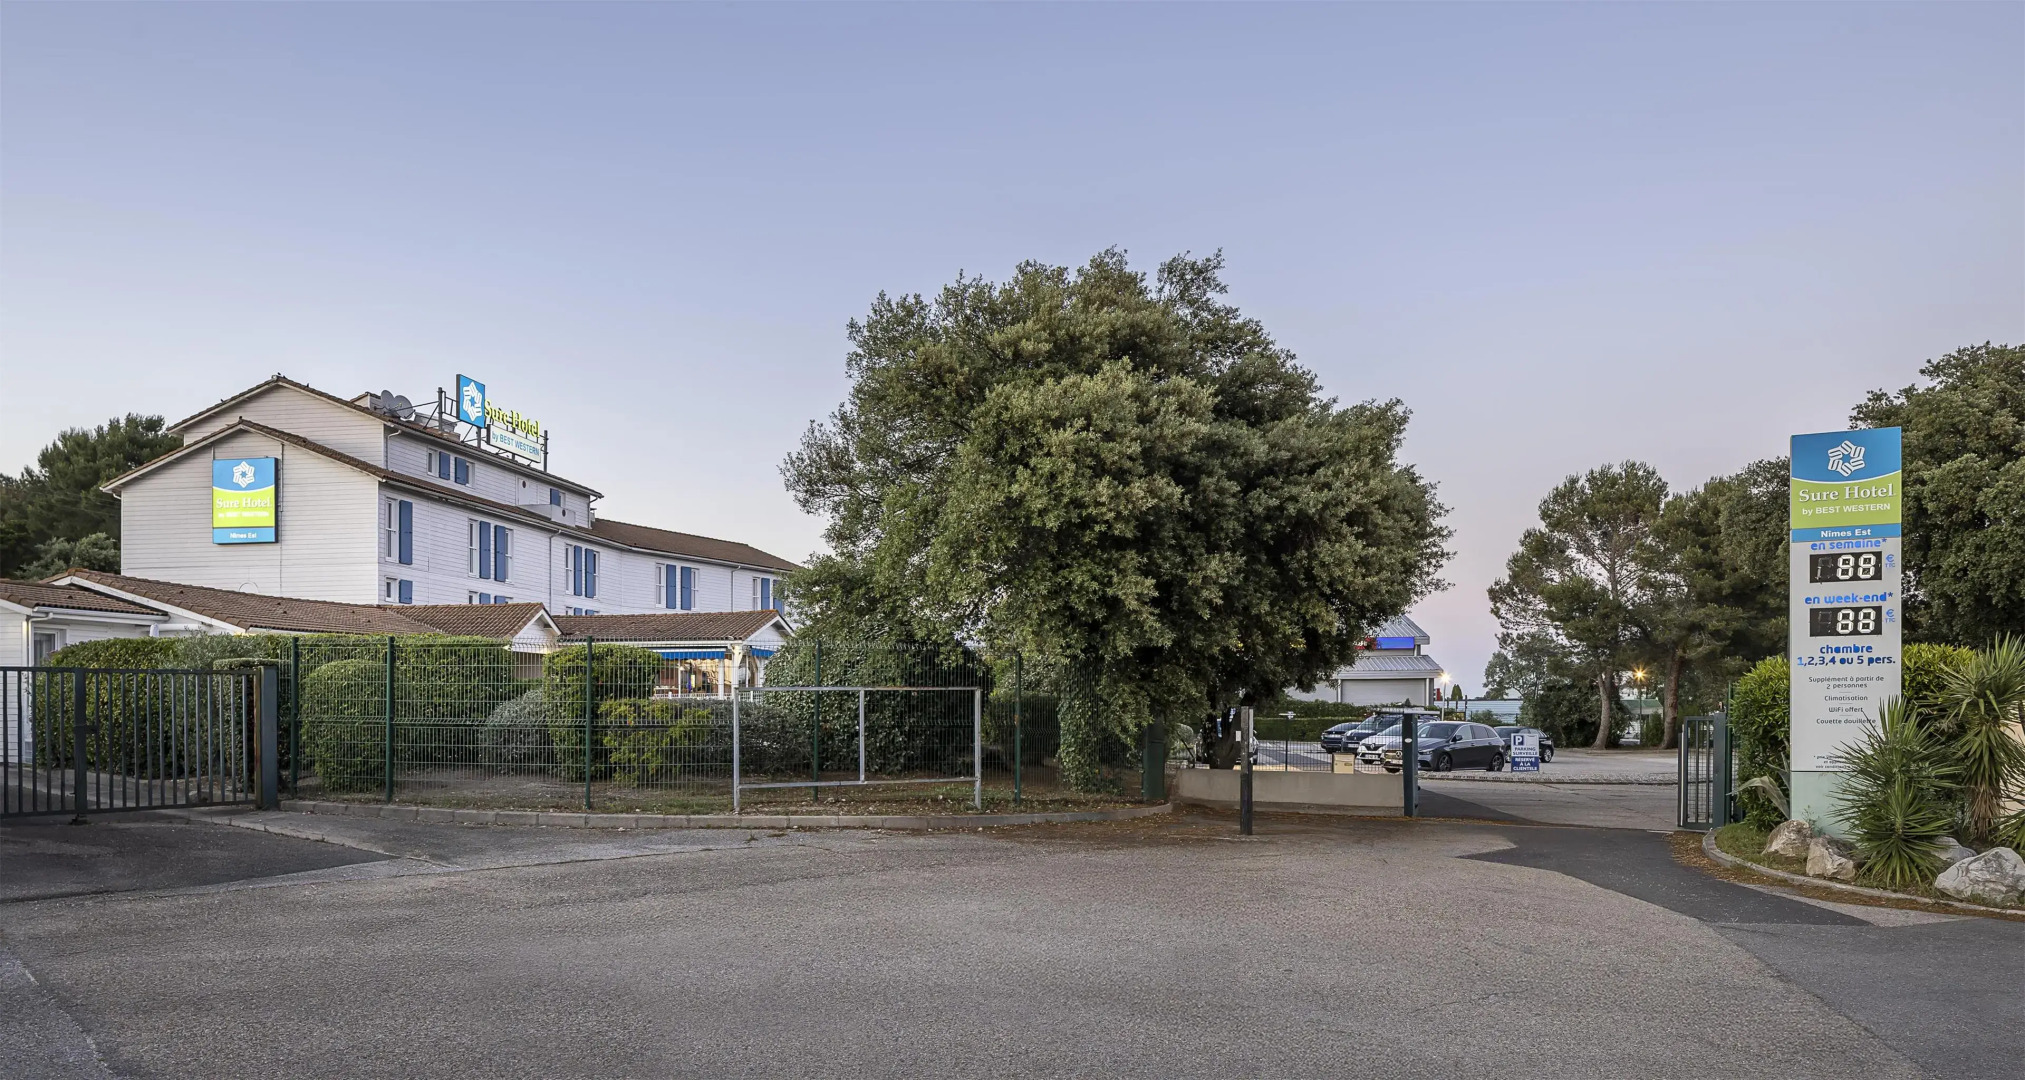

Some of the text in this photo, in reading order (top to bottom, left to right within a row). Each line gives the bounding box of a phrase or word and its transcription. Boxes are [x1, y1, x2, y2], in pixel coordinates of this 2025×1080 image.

[484, 399, 540, 438] Sure Hotel
[492, 431, 540, 456] by BEST WESTERN
[1798, 484, 1894, 502] Sure Hotel
[216, 497, 271, 508] Sure Hotel
[1802, 508, 1813, 516] by
[1843, 503, 1891, 512] WESTERN
[1811, 542, 1825, 550] en
[1804, 596, 1820, 604] en
[1820, 644, 1873, 654] chambre
[1797, 656, 1896, 666] 1,2,3,4 ou 5 pers.
[1516, 736, 1522, 745] P
